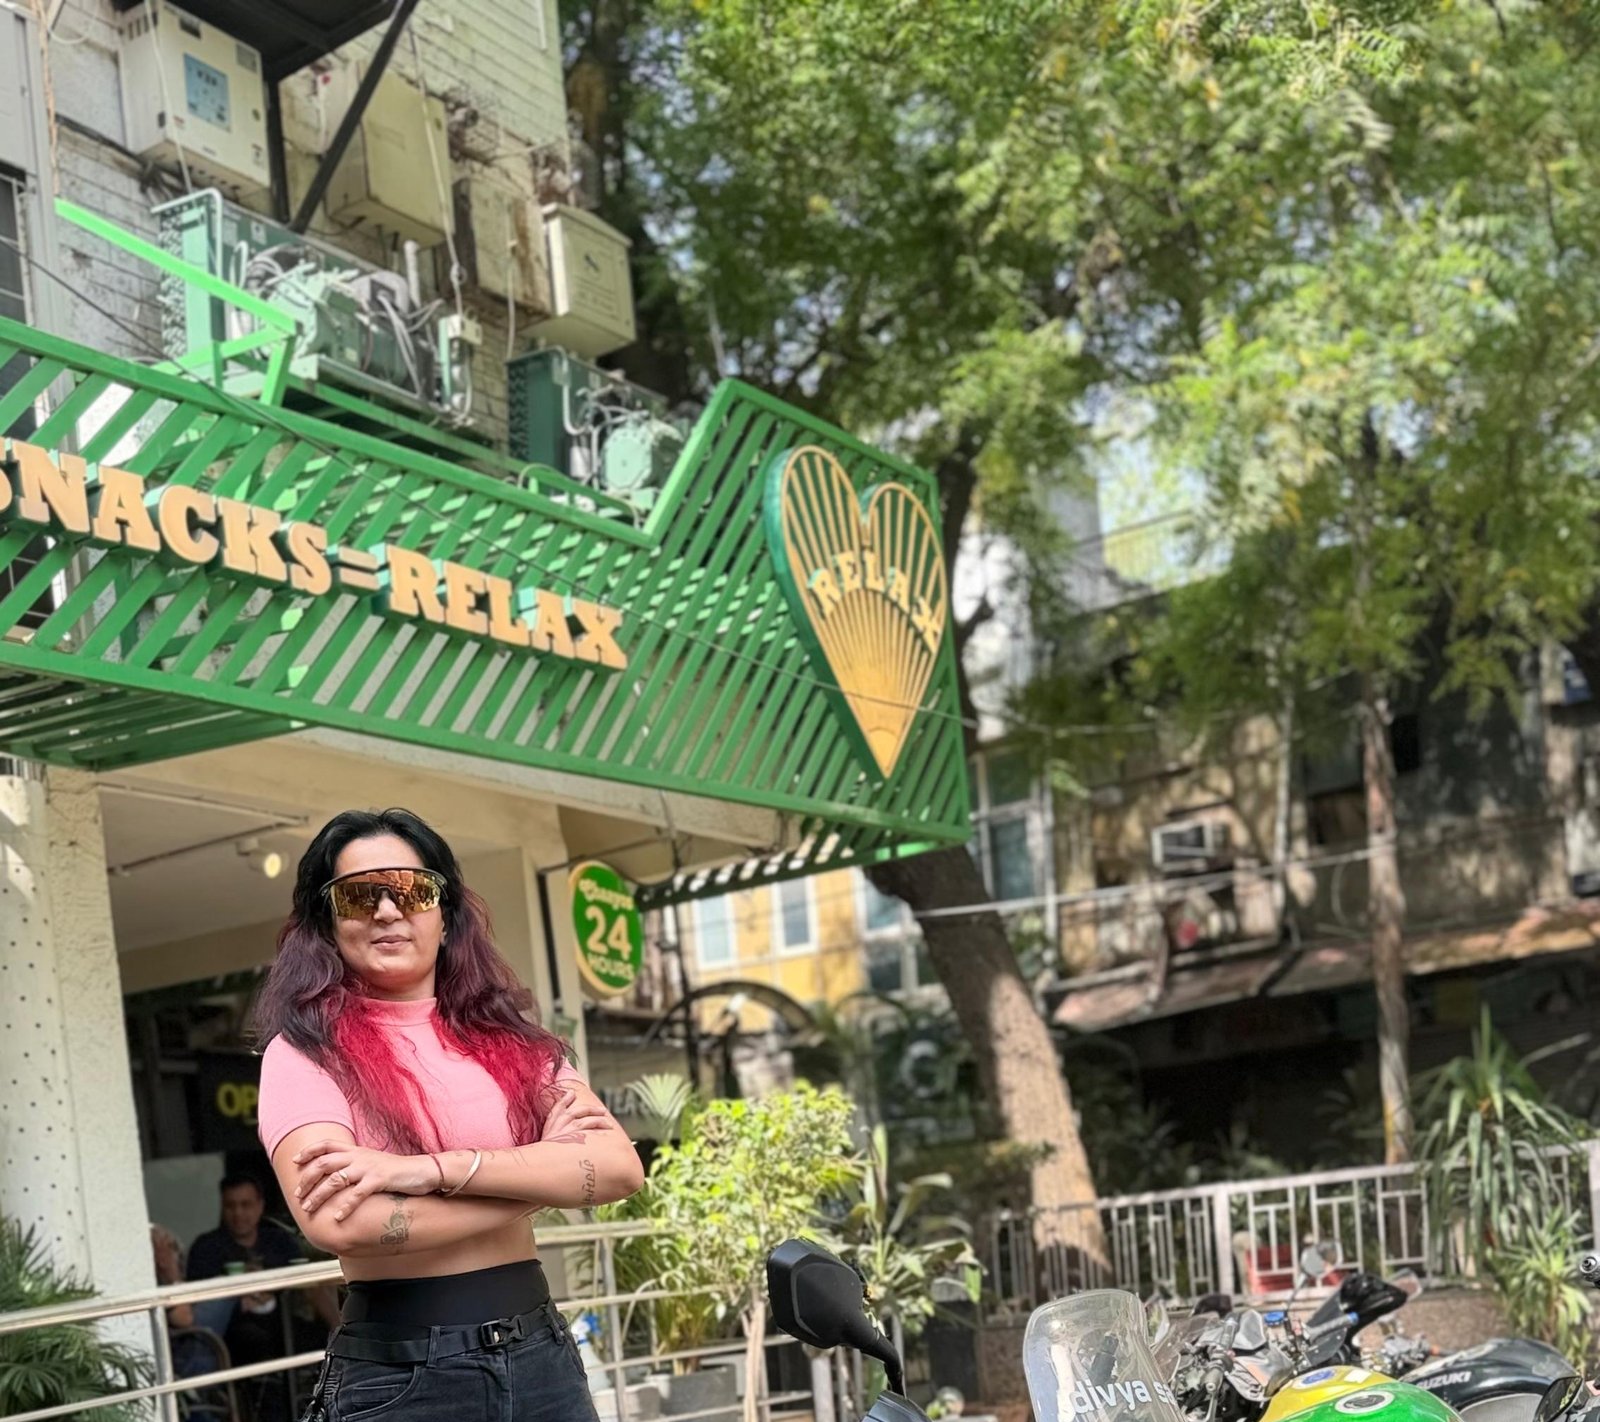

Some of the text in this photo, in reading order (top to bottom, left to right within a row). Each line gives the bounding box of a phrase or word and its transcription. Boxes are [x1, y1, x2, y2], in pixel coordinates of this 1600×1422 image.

[807, 550, 941, 654] RELAX
[585, 905, 632, 960] 24
[217, 1083, 258, 1116] OP
[1069, 1379, 1152, 1414] divya
